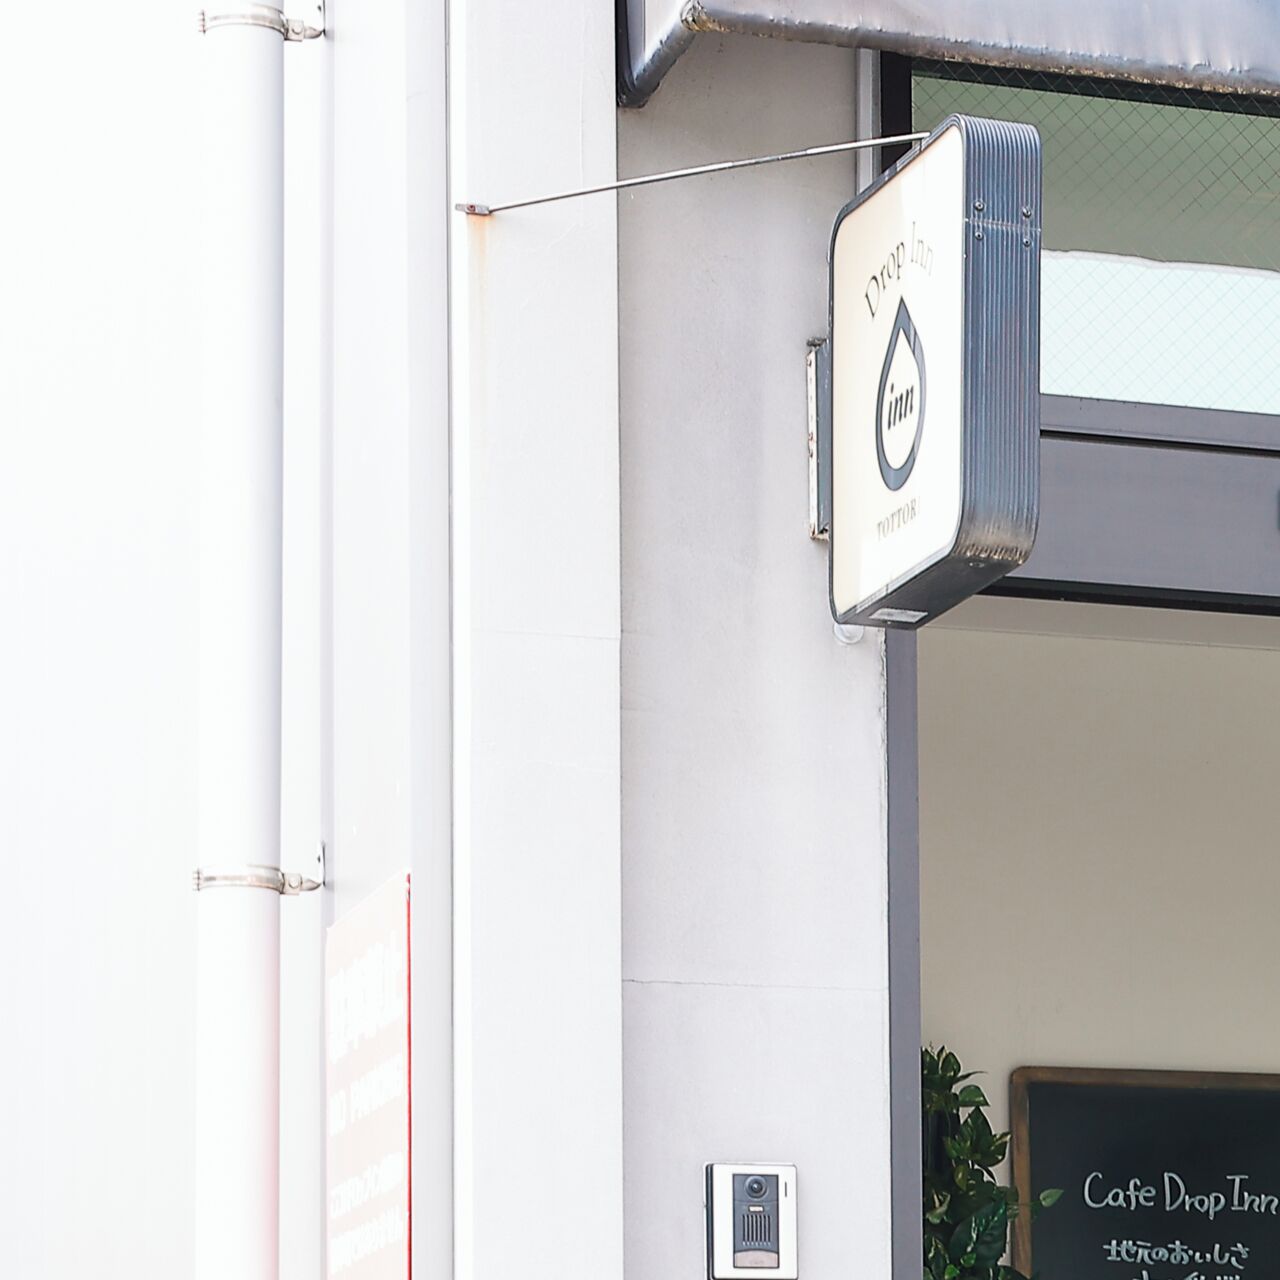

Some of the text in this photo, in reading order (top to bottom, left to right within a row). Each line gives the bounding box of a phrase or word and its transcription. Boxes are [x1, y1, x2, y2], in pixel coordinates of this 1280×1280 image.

[864, 220, 934, 319] Drop Inn
[886, 382, 915, 430] inn
[1083, 1171, 1280, 1221] Cafe Drop Inn
[1102, 1239, 1250, 1270] 地元のおいしさ
